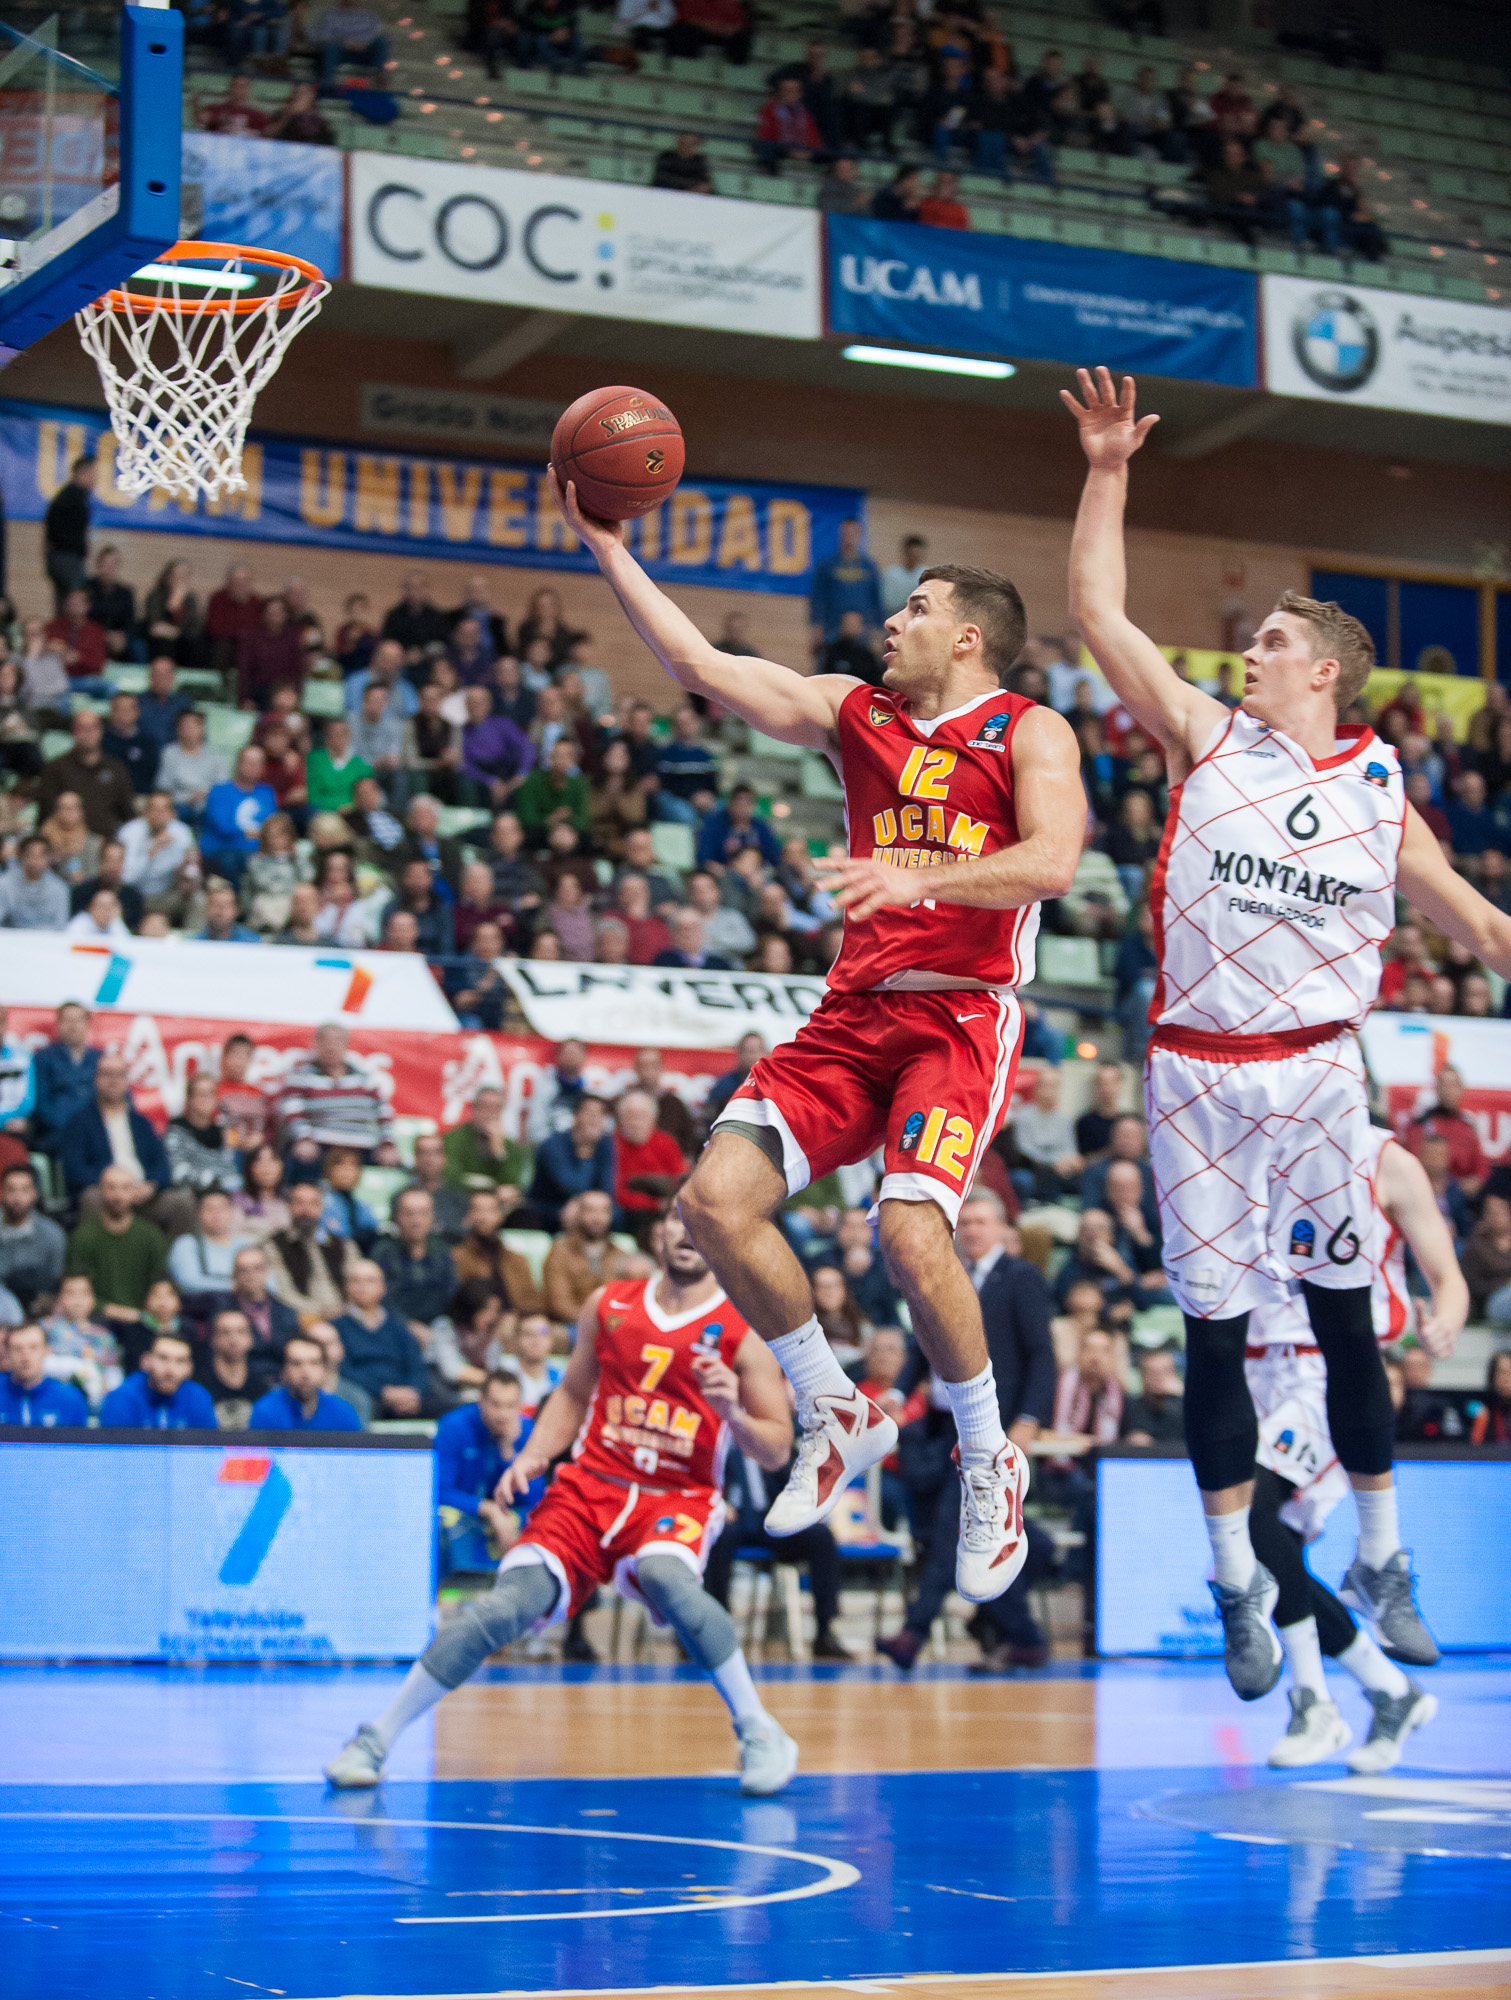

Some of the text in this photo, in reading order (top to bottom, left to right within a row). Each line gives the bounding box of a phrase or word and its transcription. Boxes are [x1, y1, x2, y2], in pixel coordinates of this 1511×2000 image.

[839, 253, 984, 311] UCAM
[301, 448, 812, 577] UNIVERIDAD
[898, 745, 959, 800] 12
[872, 804, 991, 857] UCAM
[1286, 793, 1321, 841] 6
[1208, 849, 1363, 907] MONTAKIT
[916, 1106, 975, 1181] 12
[1326, 1215, 1360, 1266] 6
[640, 1343, 674, 1392] 7
